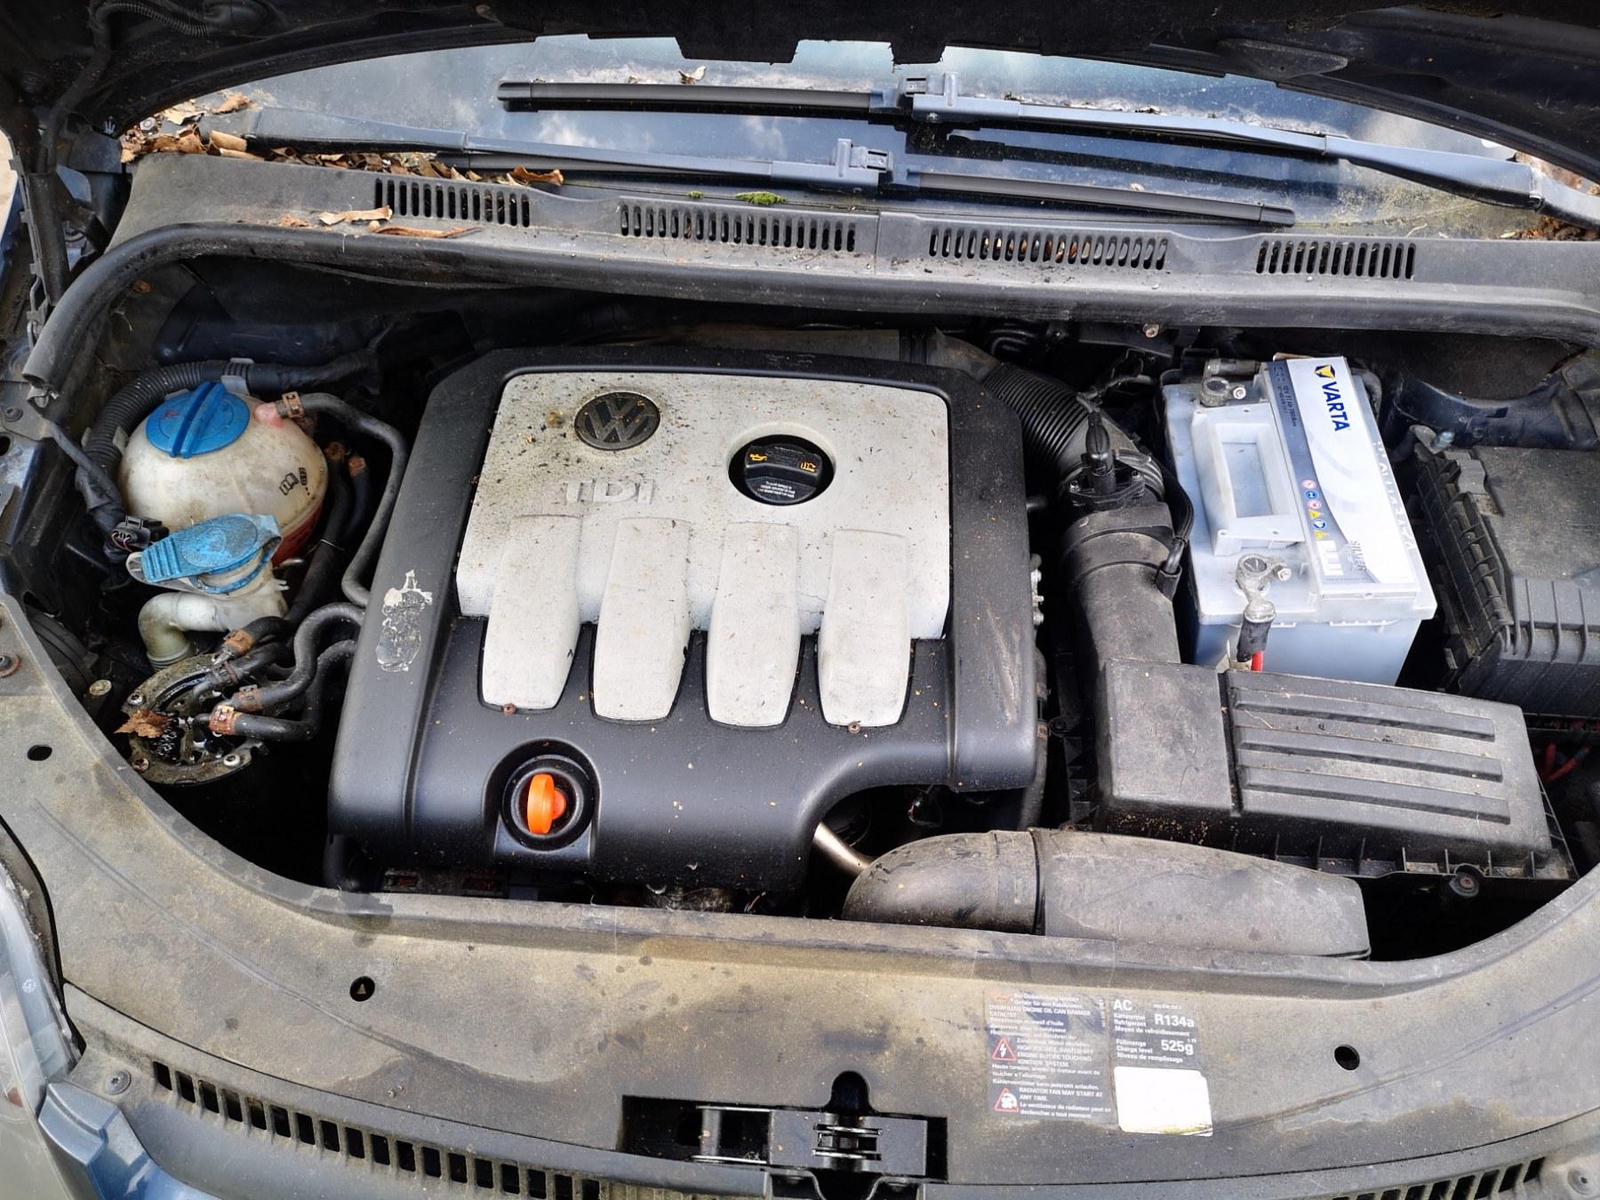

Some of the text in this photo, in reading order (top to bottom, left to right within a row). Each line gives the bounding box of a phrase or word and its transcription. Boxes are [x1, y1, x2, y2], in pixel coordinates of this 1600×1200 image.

[1322, 381, 1350, 431] VARTA
[565, 479, 655, 504] TDI
[1113, 999, 1133, 1011] AC
[1114, 1019, 1146, 1027] Refrigerant
[1154, 1013, 1195, 1028] R134a
[1116, 1045, 1137, 1053] Charge
[1161, 1039, 1194, 1055] 525g
[1117, 1052, 1138, 1060] Niveau
